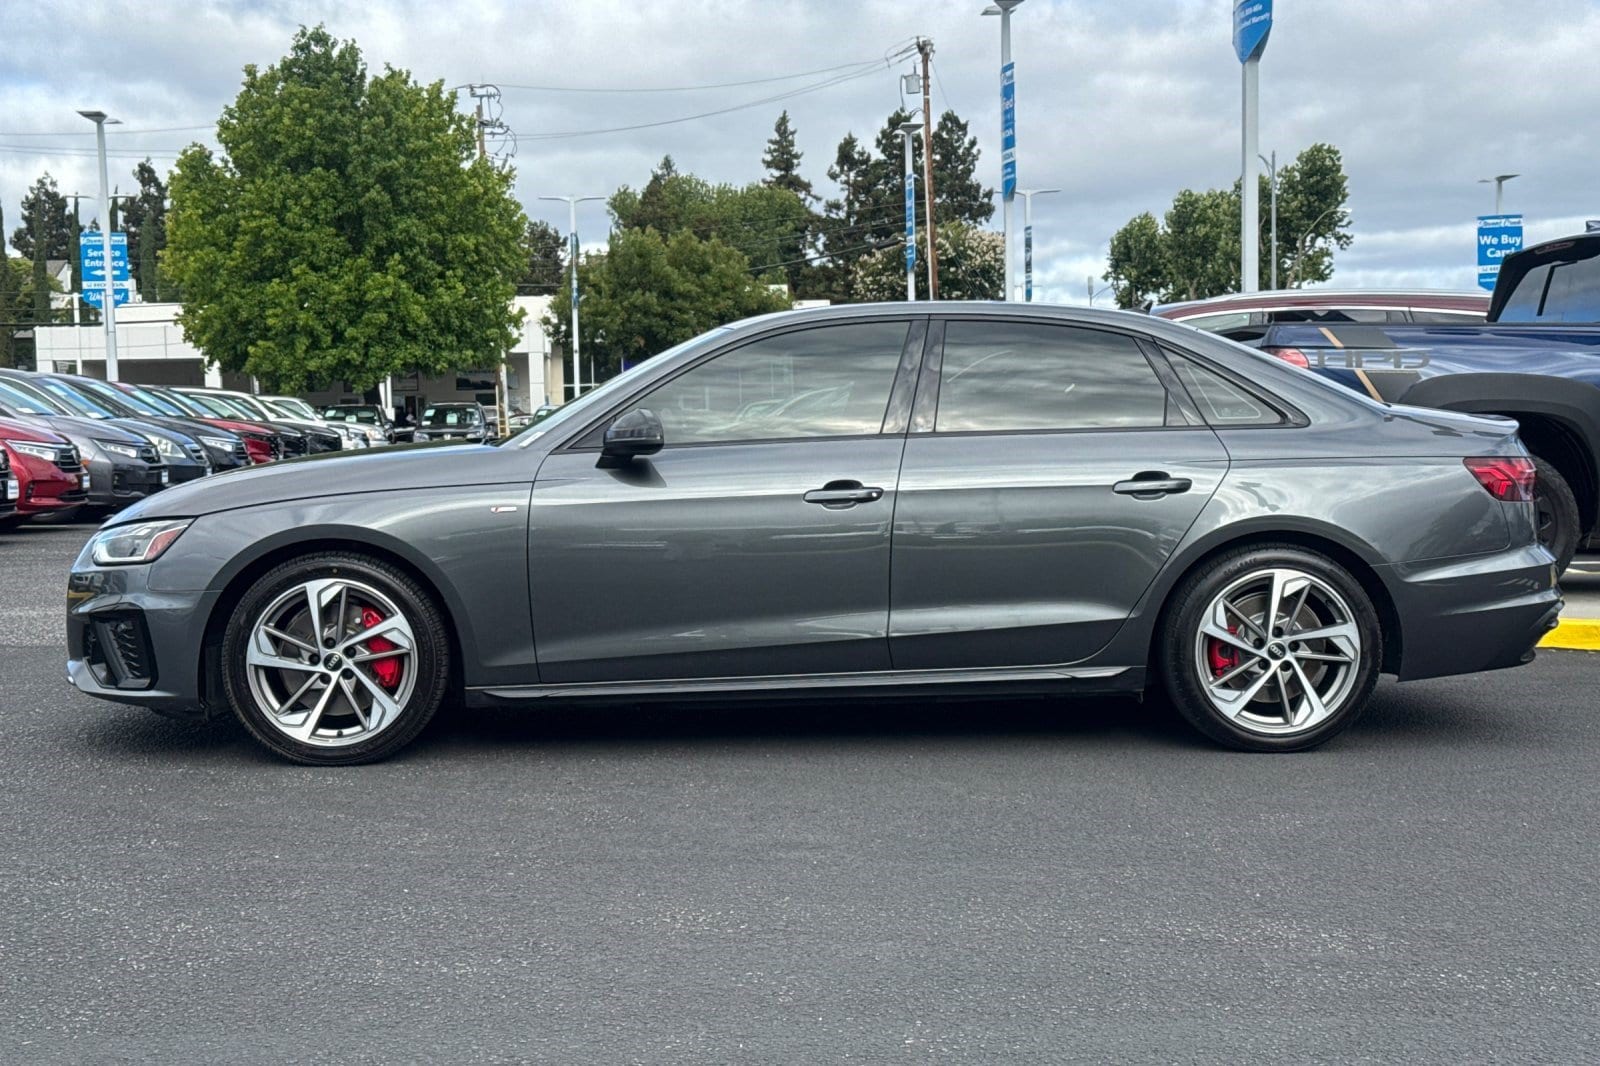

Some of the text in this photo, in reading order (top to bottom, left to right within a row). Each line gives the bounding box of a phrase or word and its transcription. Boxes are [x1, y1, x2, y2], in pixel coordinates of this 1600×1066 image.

[1479, 233, 1521, 246] We Buy
[87, 249, 121, 257] Serce
[84, 259, 124, 267] Entrce
